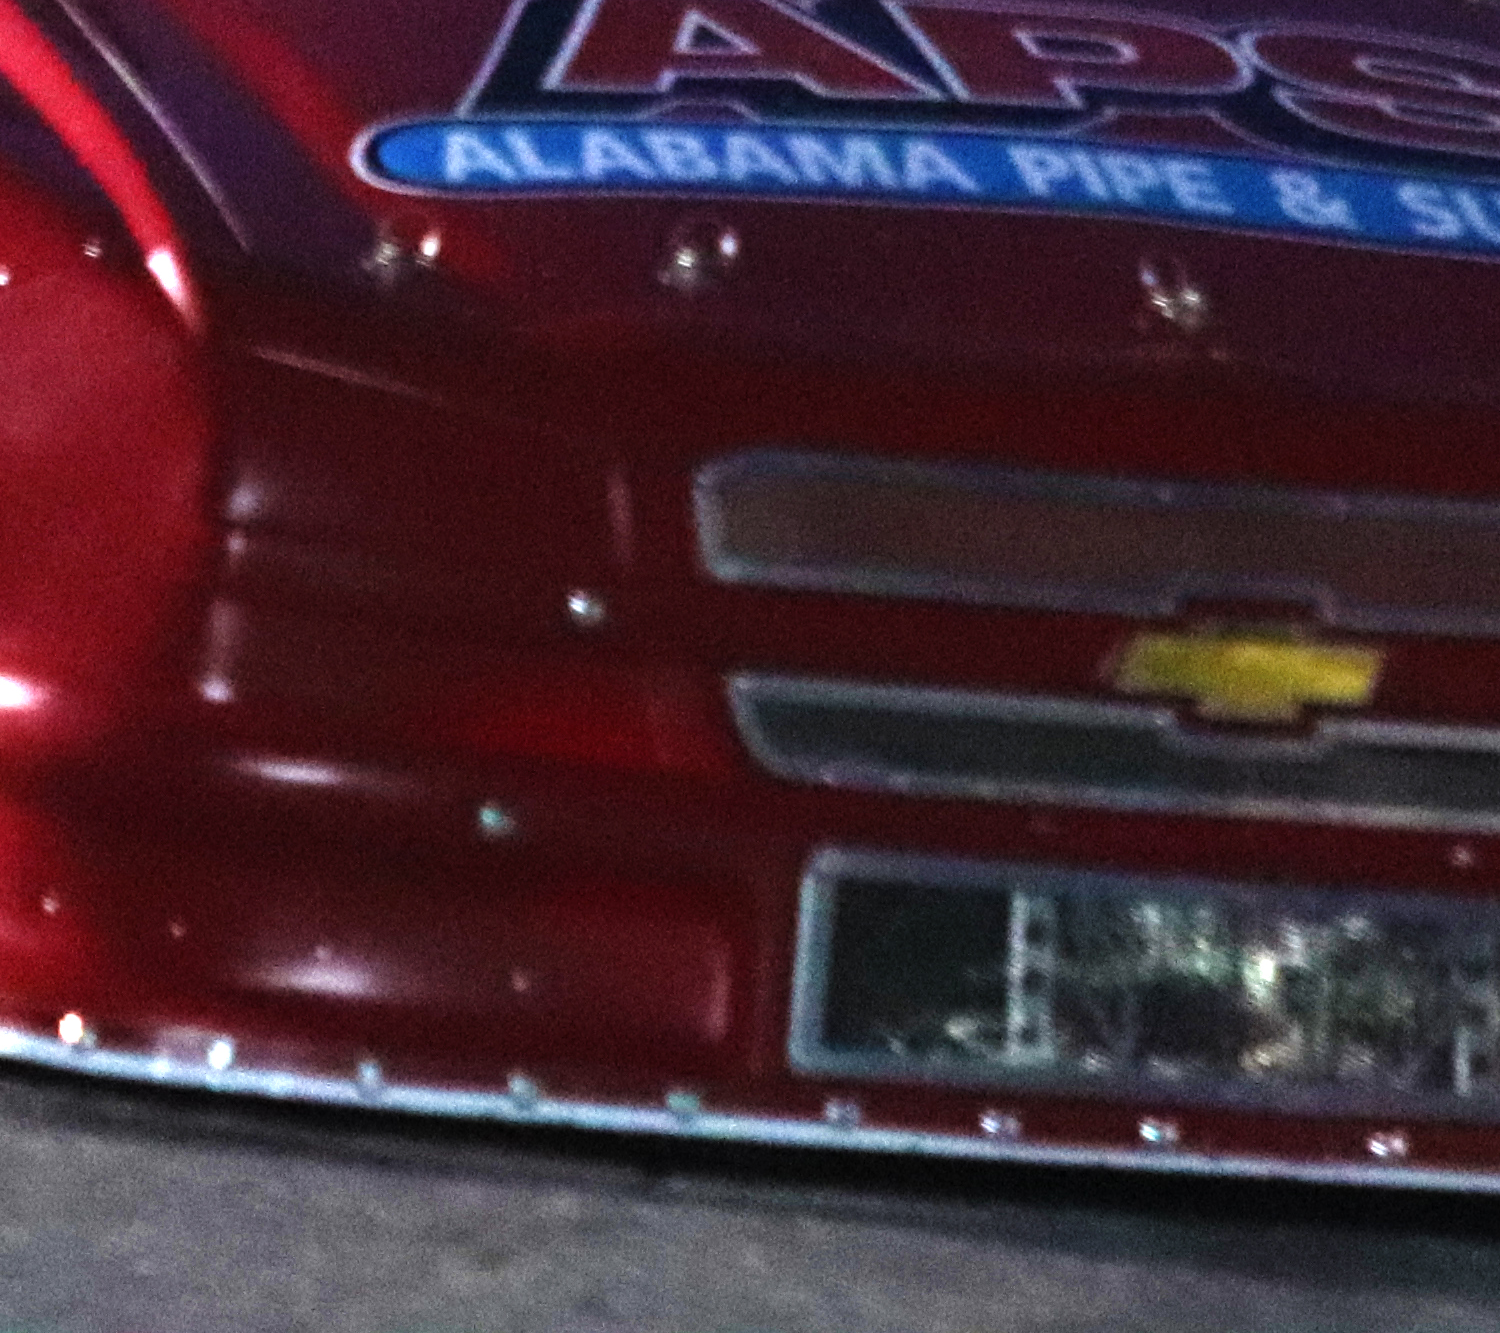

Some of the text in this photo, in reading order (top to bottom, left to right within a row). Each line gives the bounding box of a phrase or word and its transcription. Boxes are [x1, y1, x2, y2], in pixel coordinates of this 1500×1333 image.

[445, 131, 982, 194] ALABAMA
[1004, 143, 1234, 217] PIPE
[1270, 168, 1357, 230] &
